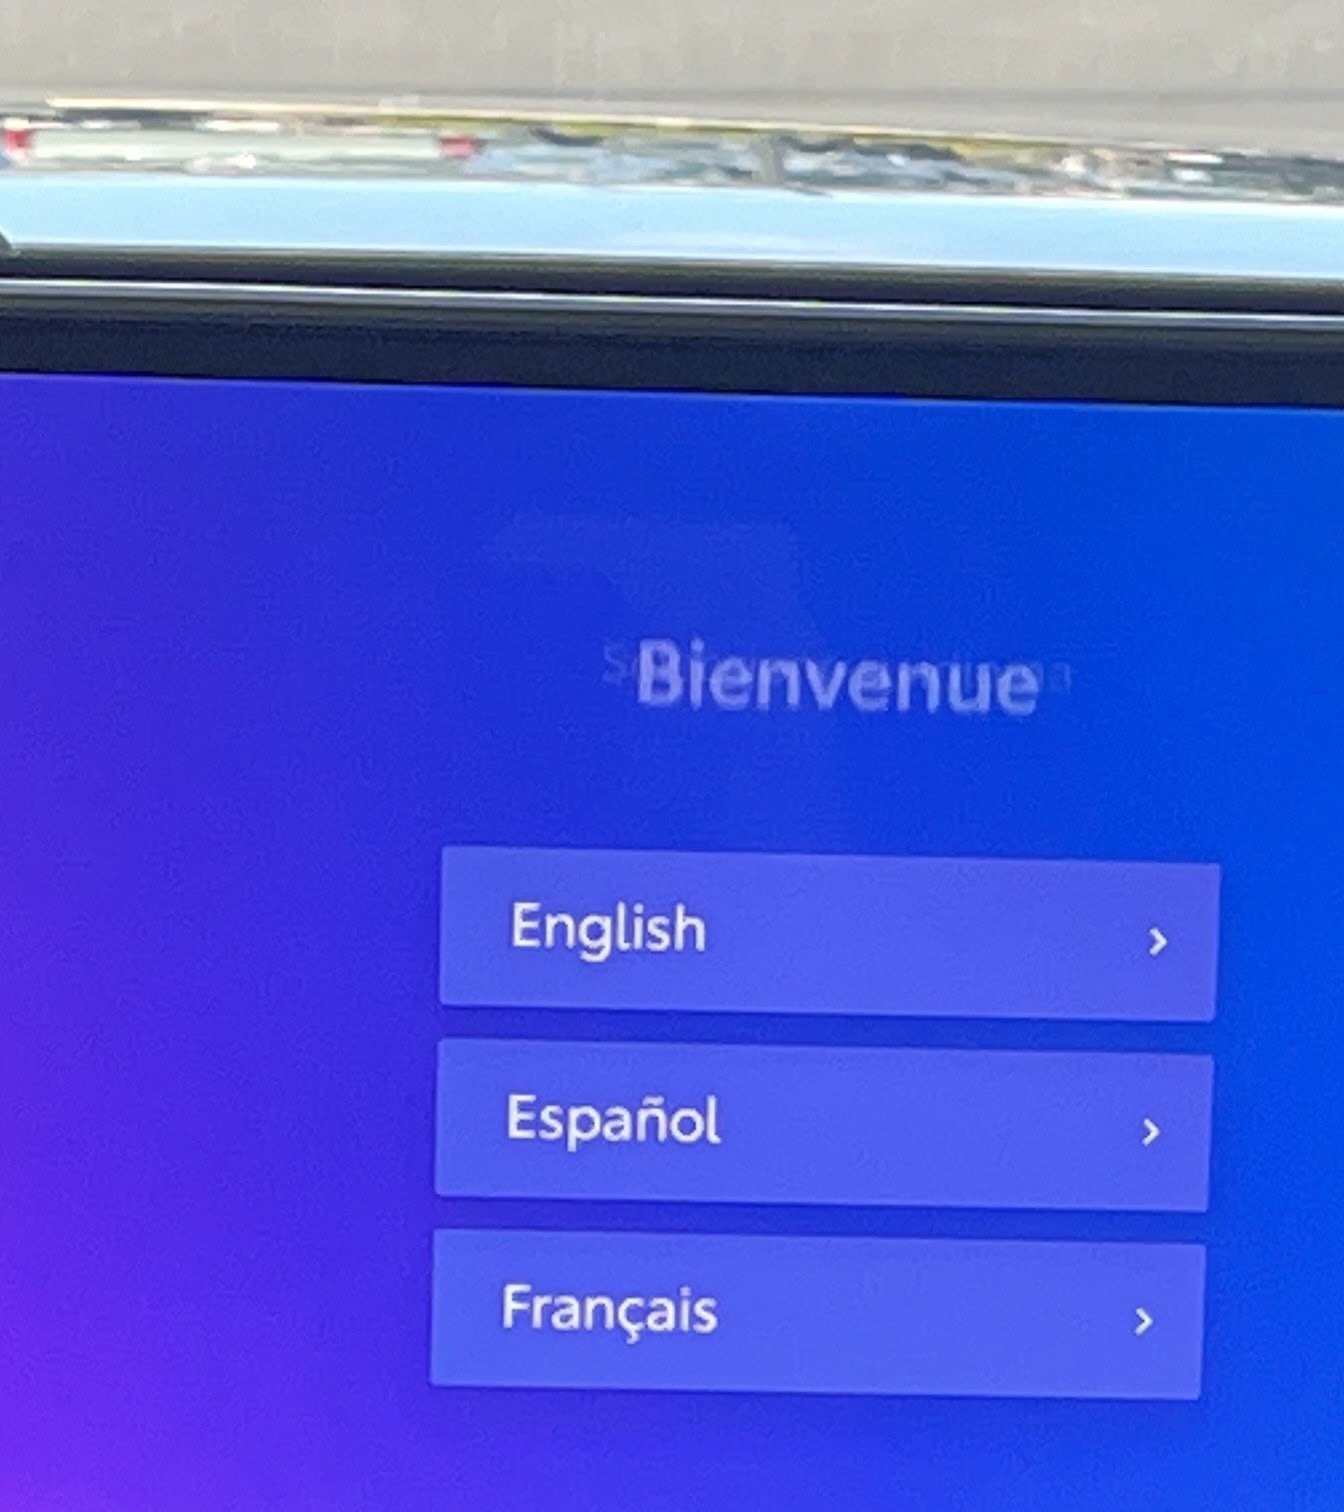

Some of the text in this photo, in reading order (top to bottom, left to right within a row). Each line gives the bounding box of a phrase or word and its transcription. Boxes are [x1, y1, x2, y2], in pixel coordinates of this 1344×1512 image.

[637, 636, 1042, 716] Bienvenue
[511, 902, 707, 962] English
[505, 1093, 722, 1152] Español
[501, 1283, 719, 1344] Français
